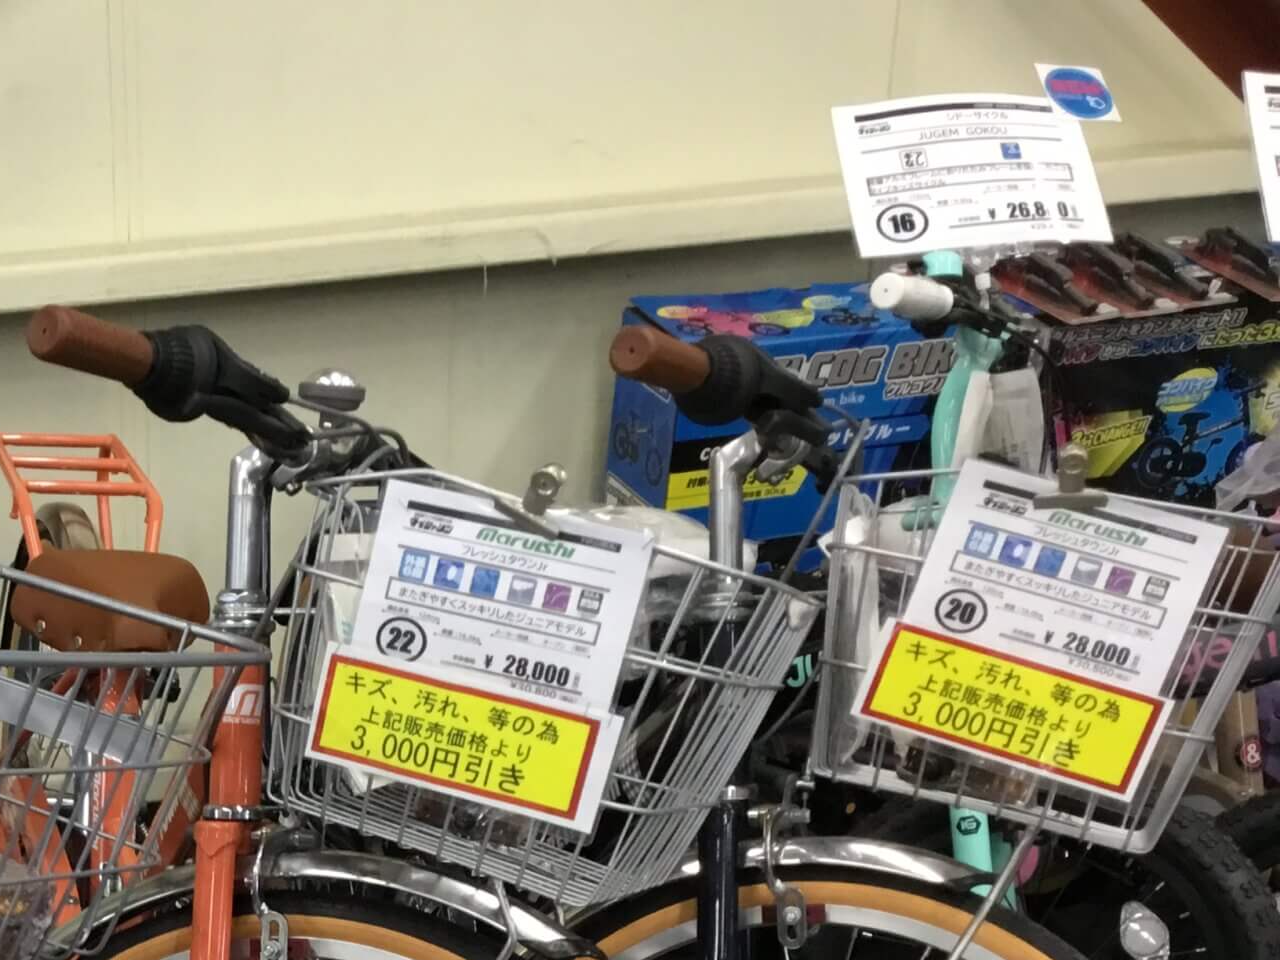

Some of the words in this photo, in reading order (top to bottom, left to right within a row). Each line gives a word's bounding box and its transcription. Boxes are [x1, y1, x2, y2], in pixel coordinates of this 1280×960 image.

[888, 212, 916, 234] 16
[1007, 201, 1070, 220] 26,80
[944, 598, 977, 625] 20
[386, 627, 416, 654] 22
[1062, 632, 1131, 667] 28,000
[502, 655, 571, 687] 28,000
[918, 674, 1093, 740] 上記販売価格より
[361, 706, 532, 764] 上記販売価格より
